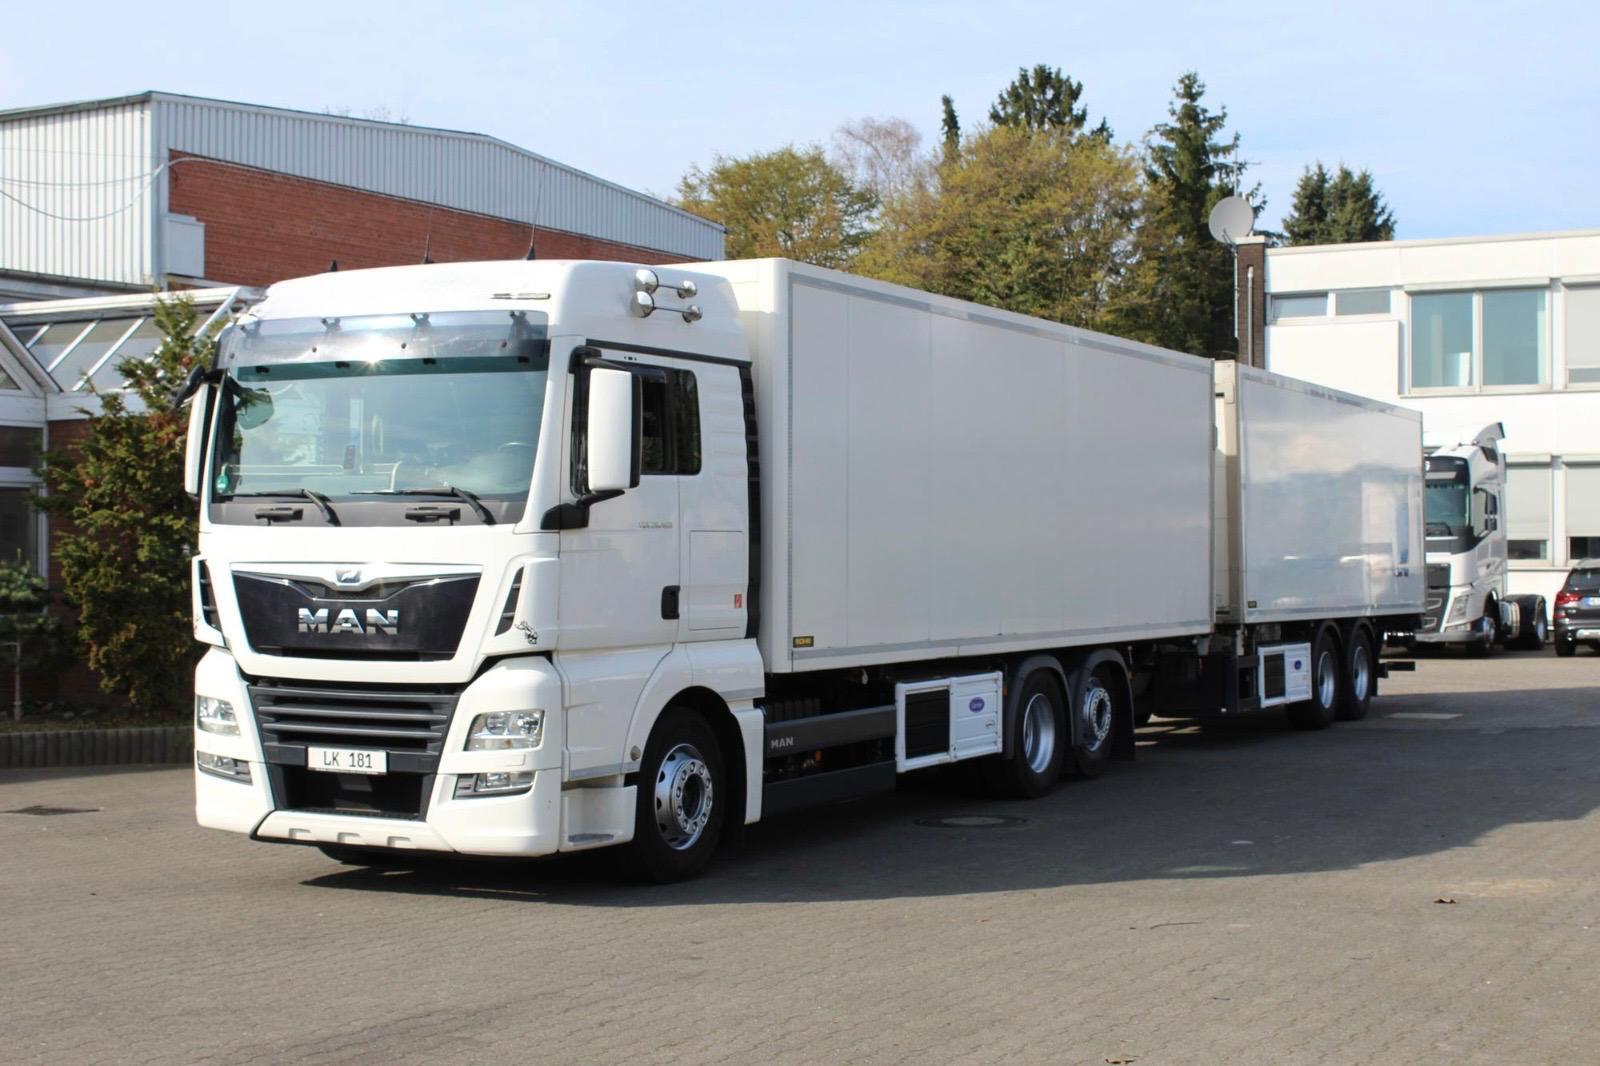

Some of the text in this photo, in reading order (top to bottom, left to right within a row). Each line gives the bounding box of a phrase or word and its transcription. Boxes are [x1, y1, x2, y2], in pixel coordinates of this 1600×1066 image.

[298, 608, 399, 635] MAN
[770, 736, 794, 749] MAN
[323, 751, 373, 769] LK 181
